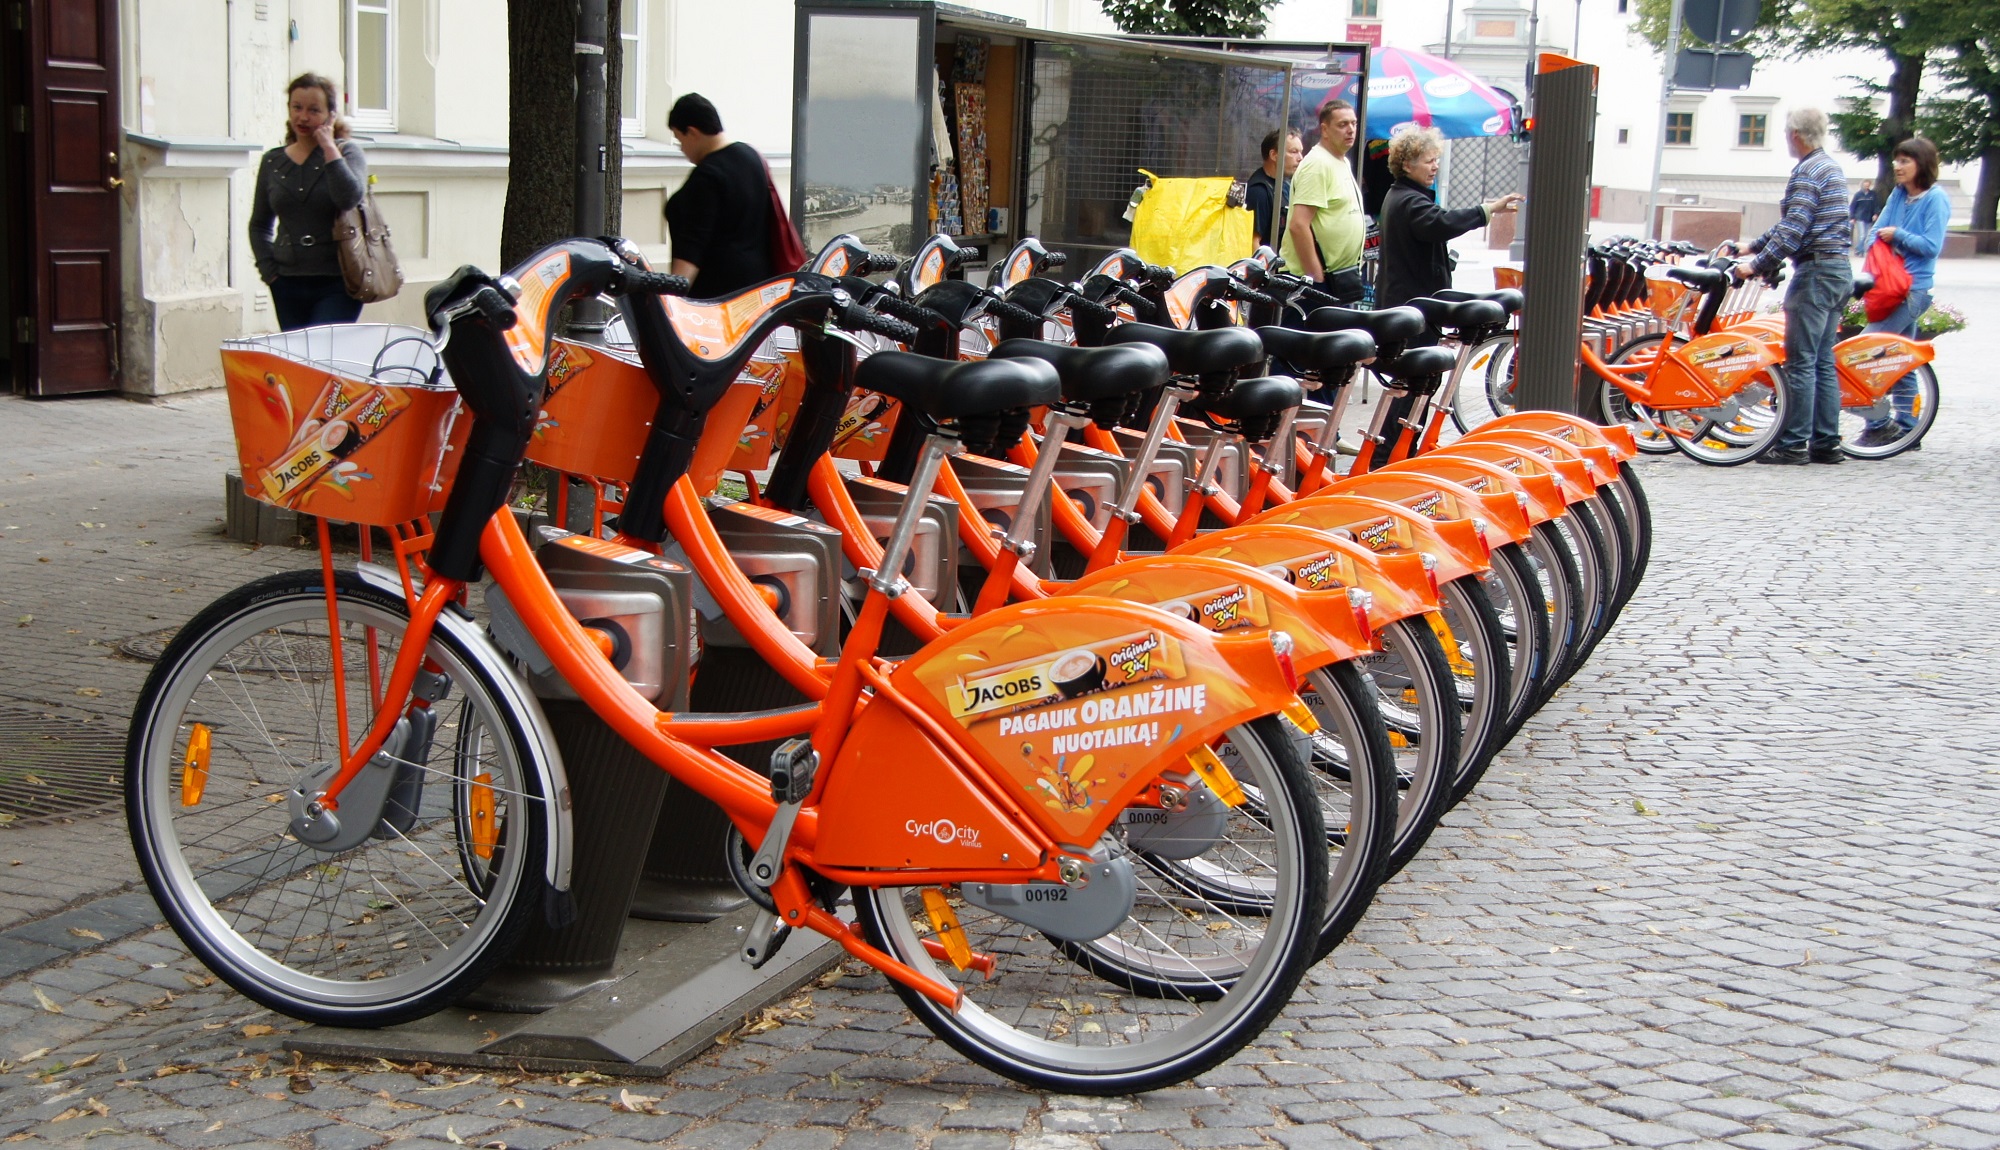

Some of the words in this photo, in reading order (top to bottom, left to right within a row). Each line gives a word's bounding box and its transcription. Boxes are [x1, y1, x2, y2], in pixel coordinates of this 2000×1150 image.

[548, 347, 567, 377] Original
[555, 360, 570, 380] 3in1
[324, 380, 343, 418] Original
[356, 390, 385, 424] Original
[368, 404, 389, 428] 3in1
[274, 450, 322, 494] JACOBS
[1410, 492, 1442, 512] Original
[1360, 517, 1394, 540] Original
[1368, 530, 1389, 549] 3in1
[1298, 550, 1337, 578] Original
[1307, 567, 1331, 588] 3in1
[1203, 586, 1245, 617] Original
[1213, 603, 1239, 628] 3in1
[1110, 633, 1158, 667] Original
[1120, 652, 1151, 680] 3in1
[964, 676, 1042, 712] JACOBS
[999, 707, 1077, 737] PAGAUK
[1080, 684, 1206, 725] ORANŽINĘ
[1052, 722, 1159, 755] NUOTAIKĄ!
[960, 839, 982, 848] Vilnius
[1025, 888, 1068, 902] 00192
